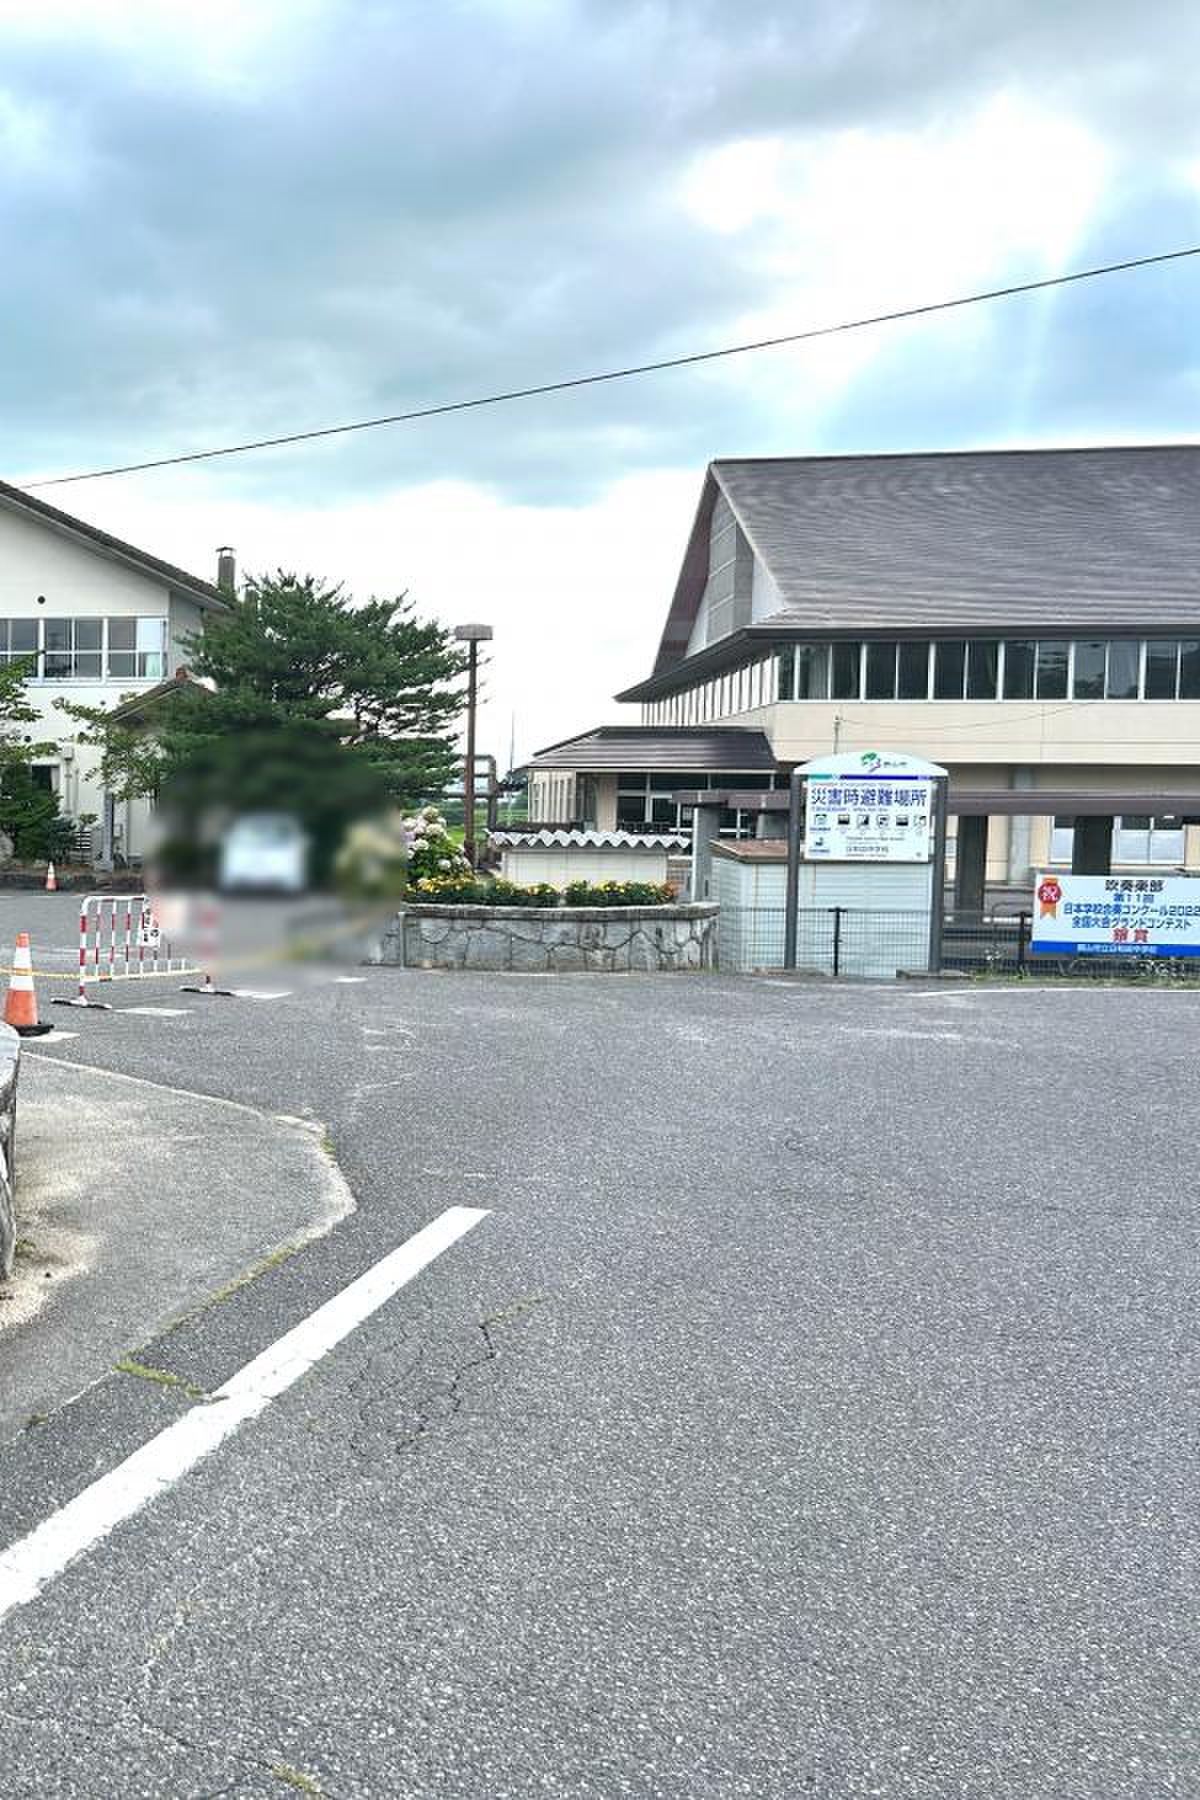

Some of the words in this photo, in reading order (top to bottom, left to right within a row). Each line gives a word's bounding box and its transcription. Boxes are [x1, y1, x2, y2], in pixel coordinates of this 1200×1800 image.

[811, 787, 927, 807] 災害時避難場所
[1040, 885, 1059, 901] 祝
[1105, 879, 1164, 893] 吹奏楽部
